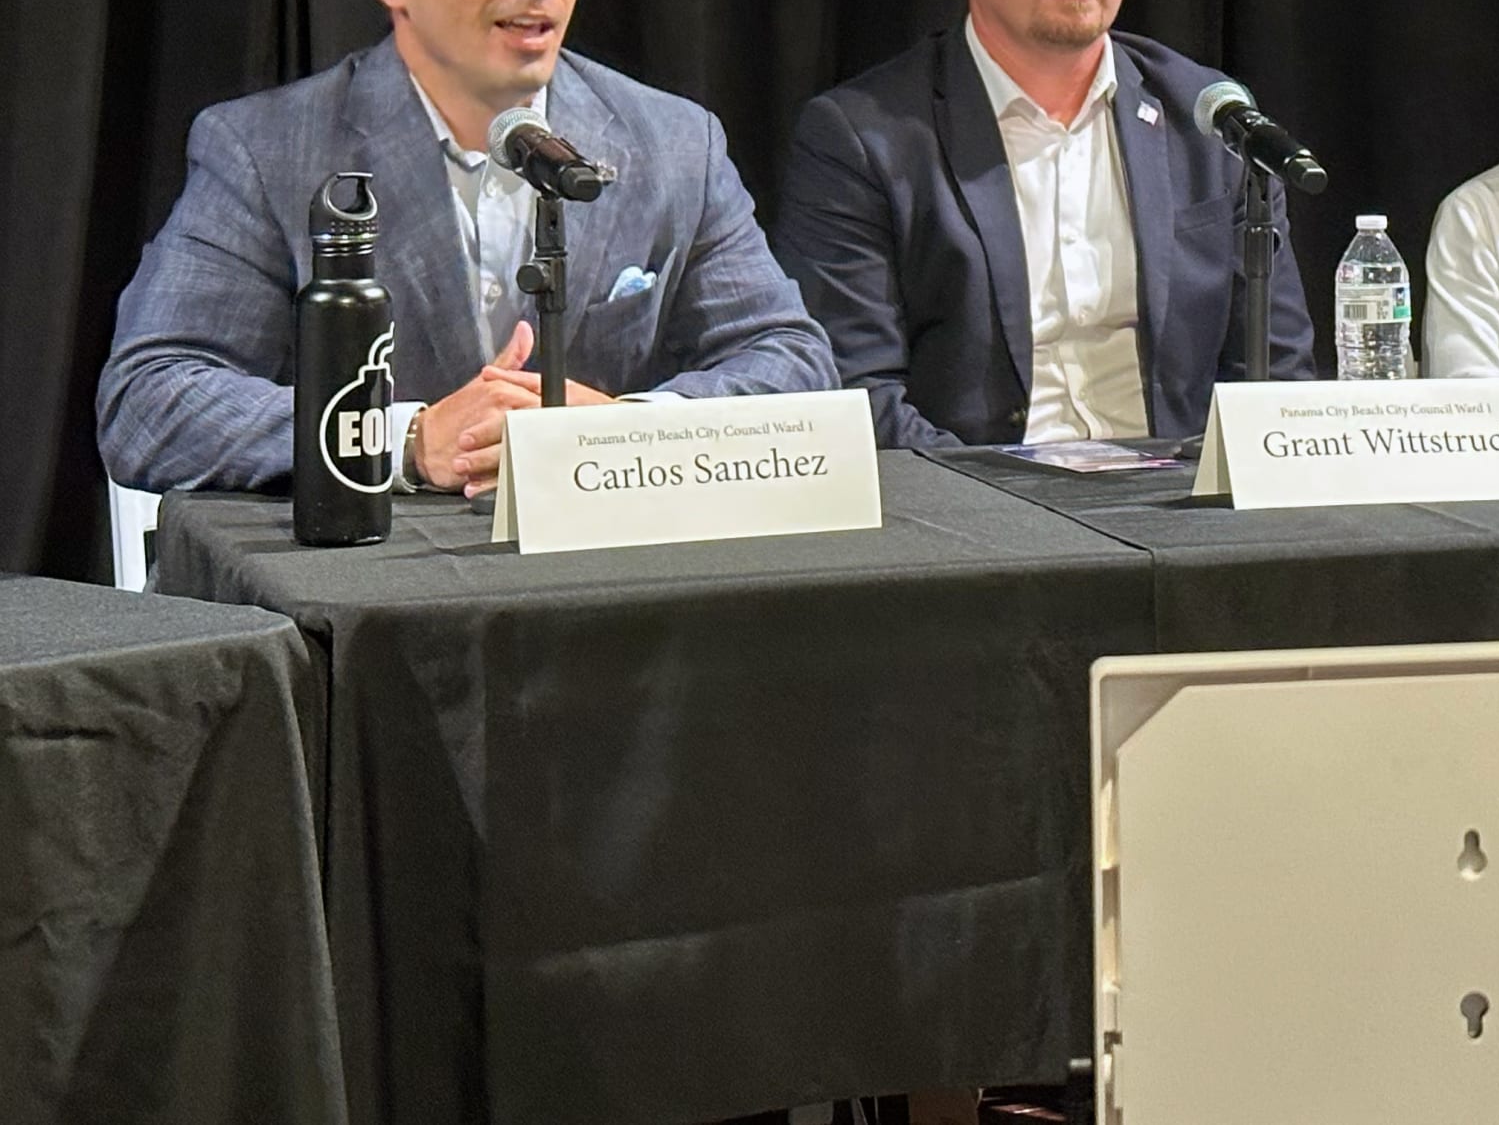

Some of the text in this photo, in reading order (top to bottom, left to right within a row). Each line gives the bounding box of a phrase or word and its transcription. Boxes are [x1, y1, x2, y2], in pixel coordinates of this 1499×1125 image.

[1280, 402, 1492, 418] Panama City Beach City Council Ward 1
[577, 420, 814, 447] Panama City Beach City Council Ward 1
[1263, 429, 1355, 458] Grant
[574, 448, 828, 492] Carlos Sanchez
